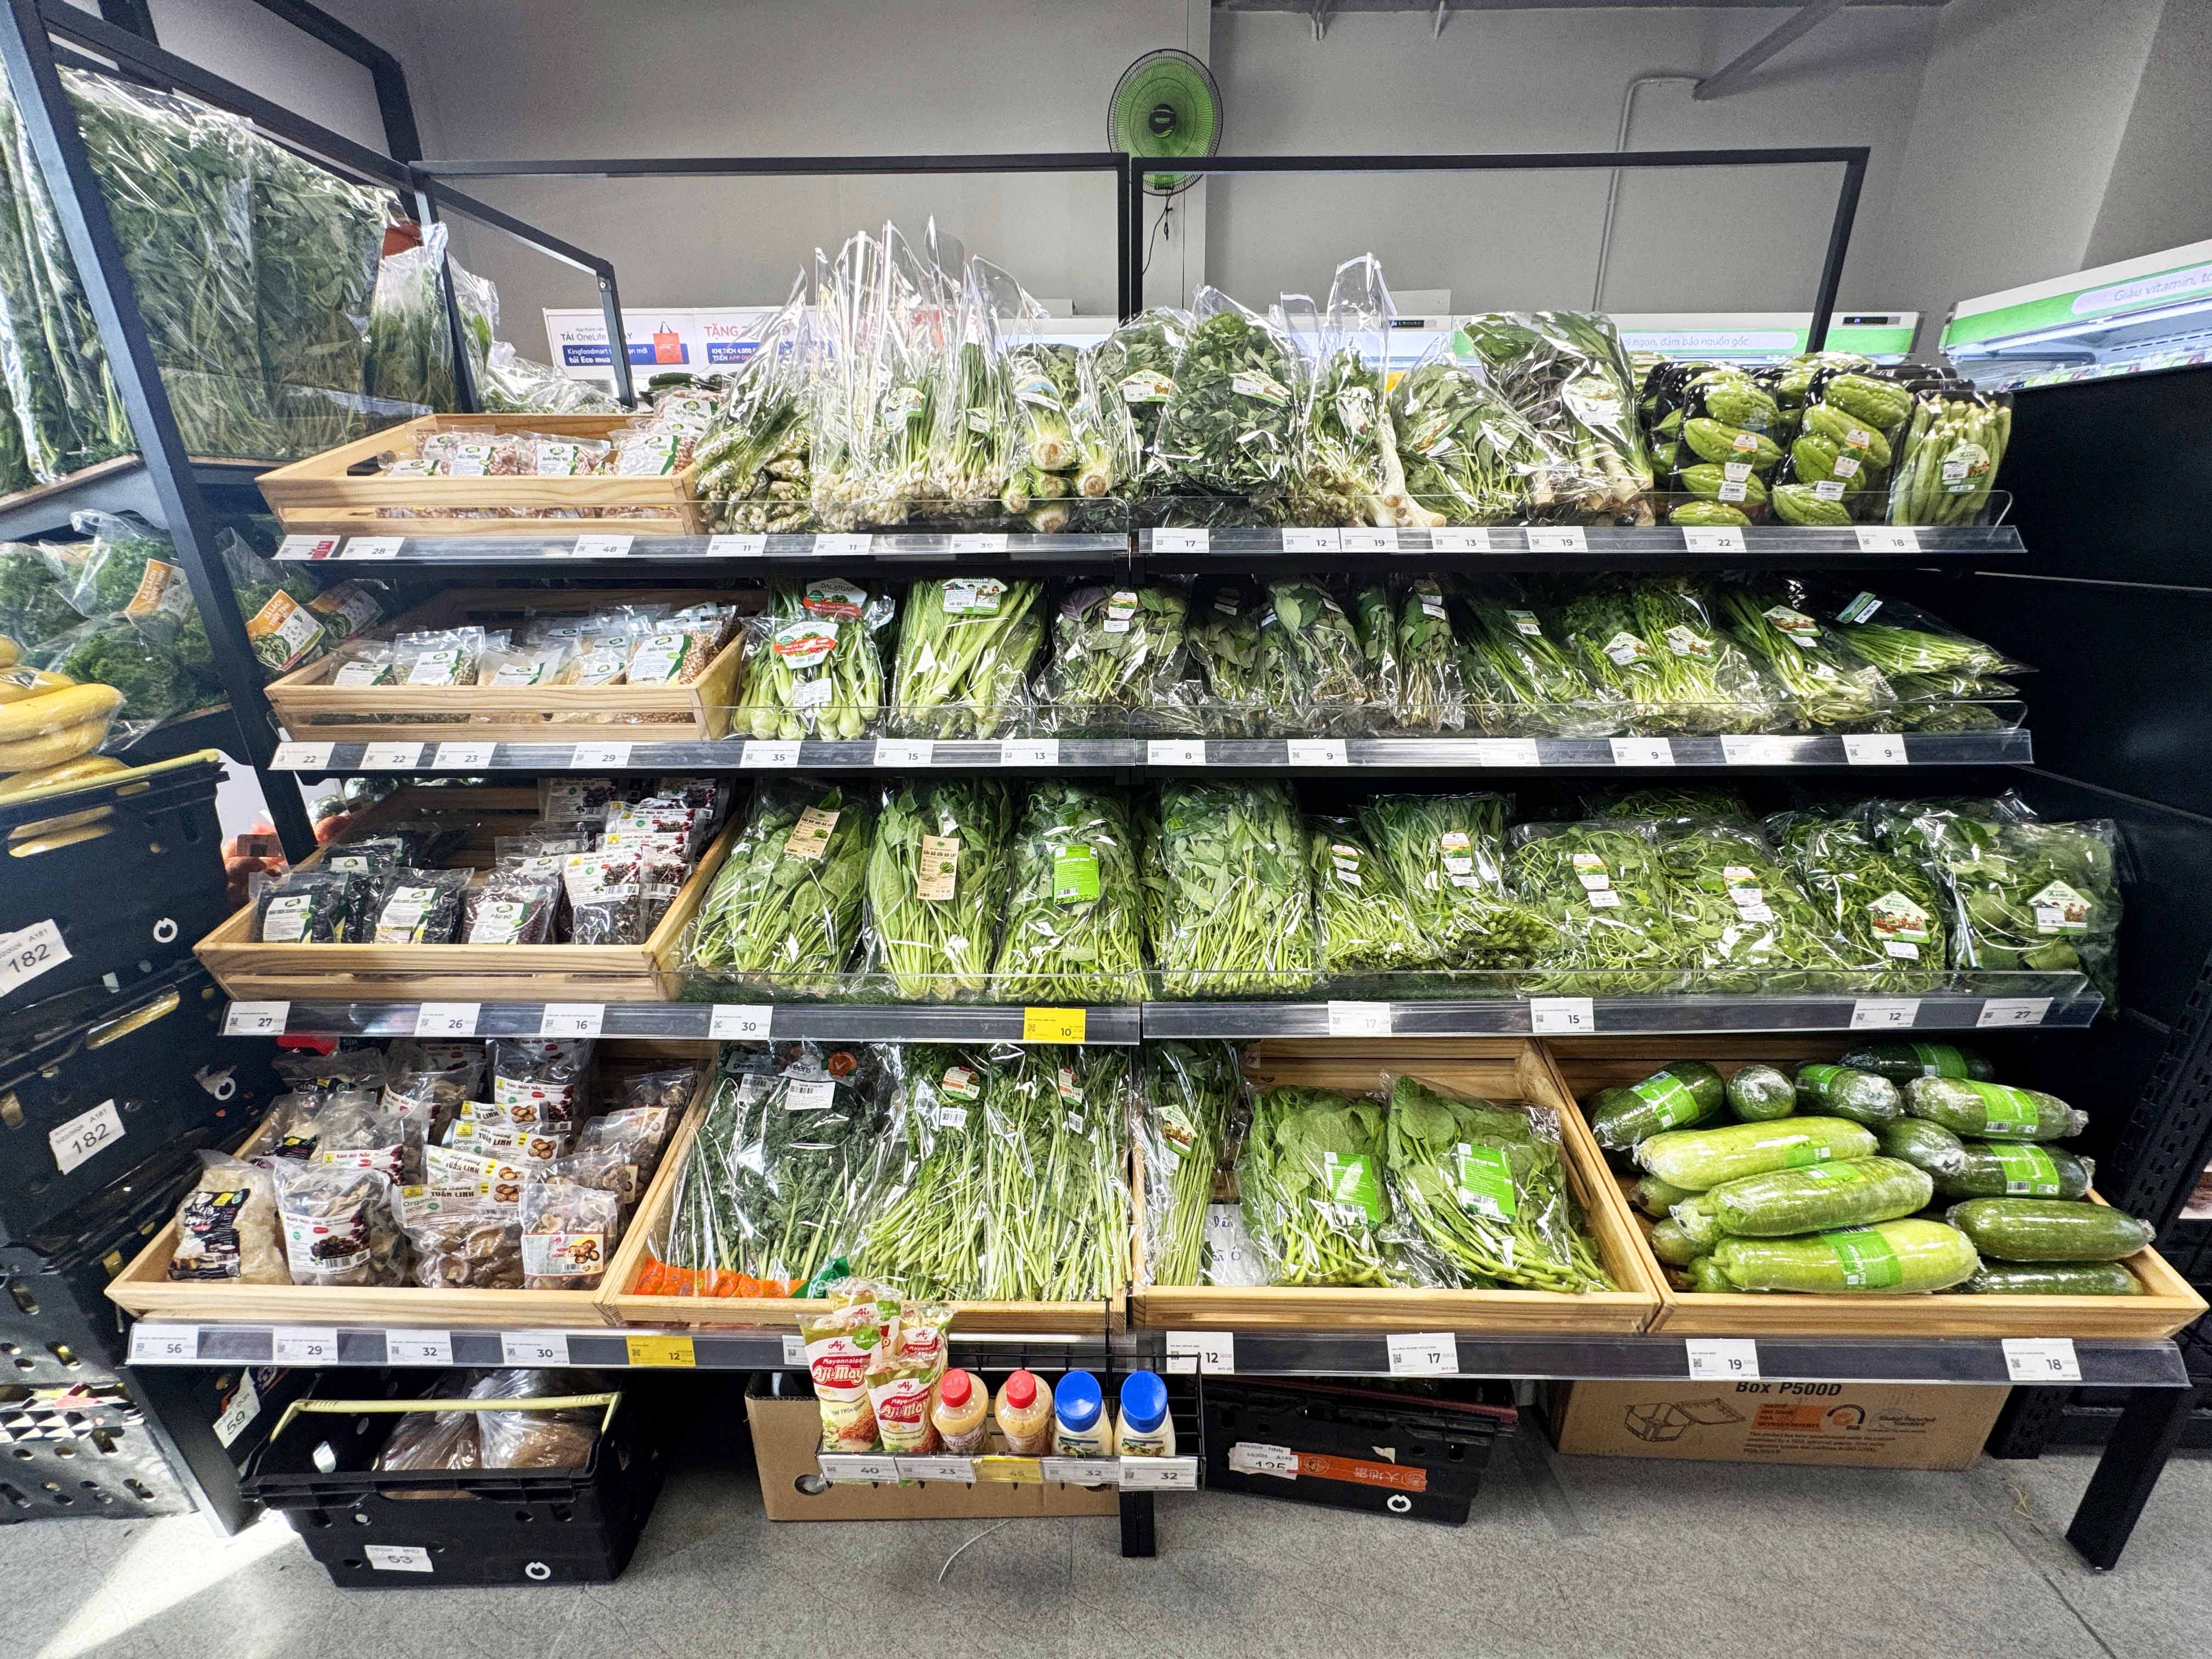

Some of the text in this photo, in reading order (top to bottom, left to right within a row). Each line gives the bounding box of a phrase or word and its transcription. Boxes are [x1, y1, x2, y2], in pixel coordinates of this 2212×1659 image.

[2114, 287, 2143, 302] Giàu
[2145, 275, 2198, 296] vitamin,
[704, 324, 739, 340] TẶNG
[1884, 749, 1892, 758] 9
[392, 755, 406, 763] 22
[8, 944, 51, 973] 182
[1567, 1015, 1579, 1024] 15
[1889, 1012, 1901, 1020] 12
[2014, 1011, 2032, 1019] 27
[258, 1018, 273, 1027] 27
[448, 1019, 463, 1029] 26
[576, 1020, 588, 1030] 16
[741, 1022, 757, 1031] 30
[1364, 1018, 1376, 1029] 17
[1060, 1028, 1071, 1036] 10
[790, 1064, 816, 1074] reens+
[72, 1123, 110, 1154] 182
[166, 1344, 182, 1353] 56
[307, 1345, 323, 1355] 29
[422, 1347, 437, 1356] 32
[537, 1349, 554, 1358] 30
[668, 1352, 681, 1361] 12
[823, 1357, 864, 1366] Mayonnaise
[1205, 1352, 1218, 1363] 12
[1427, 1353, 1441, 1364] 17
[1728, 1359, 1742, 1370] 19
[2046, 1359, 2062, 1370] 18
[812, 1364, 865, 1386] Aji-May
[1736, 1381, 1842, 1396] Box P500D
[891, 1390, 928, 1406] Mayonnaise
[227, 1410, 246, 1435] 59
